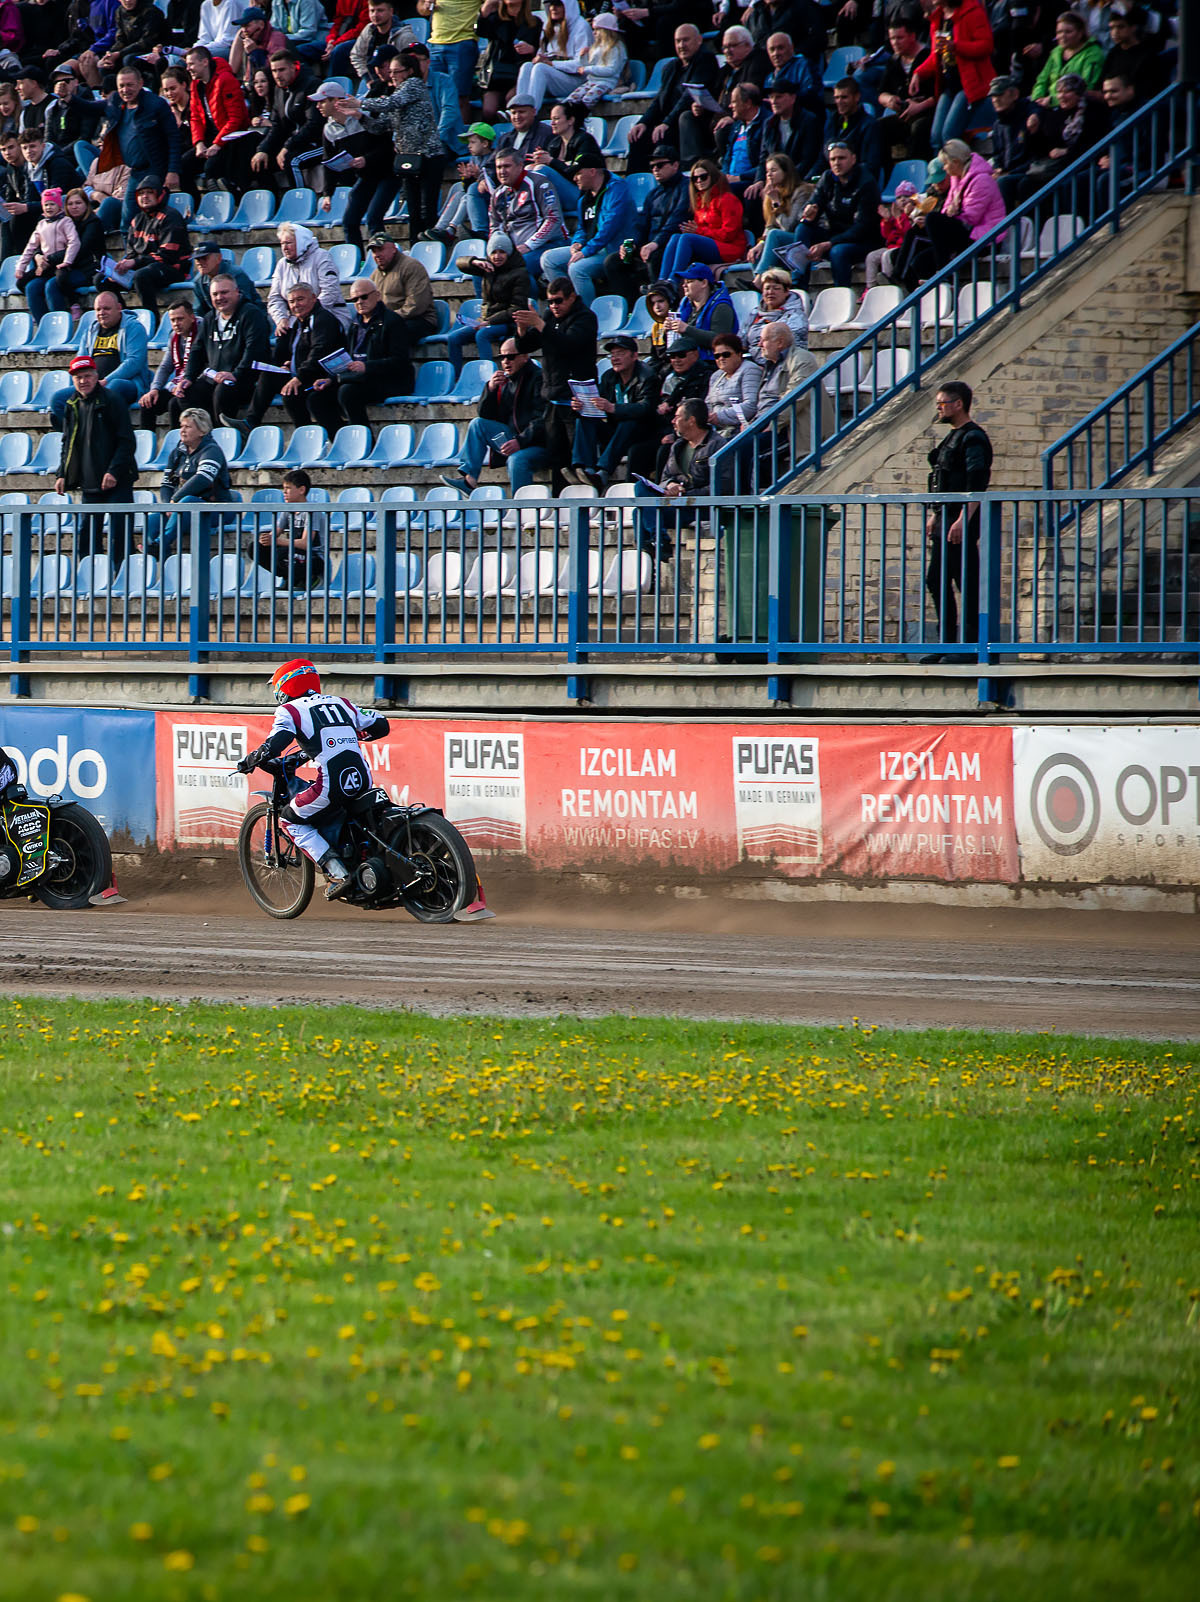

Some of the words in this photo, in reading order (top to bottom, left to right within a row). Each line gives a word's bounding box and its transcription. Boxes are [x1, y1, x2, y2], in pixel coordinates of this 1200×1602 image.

[319, 705, 345, 723] 11
[177, 730, 242, 761] PUFAS
[449, 738, 519, 770] PUFAS
[738, 743, 813, 775] PUFAS
[580, 748, 676, 777] IZCILAM
[879, 751, 981, 781] IZCILAM
[177, 774, 196, 787] MADE
[198, 775, 207, 788] IN
[210, 776, 243, 789] GERMANY
[449, 784, 470, 797] MADE
[473, 785, 481, 797] IN
[484, 785, 520, 798] GERMANY
[561, 789, 697, 819] REMONTAM
[739, 790, 761, 803] MADE
[764, 791, 773, 803] IN
[776, 791, 816, 804] GERMANY
[861, 794, 1002, 824] REMONTAM
[563, 828, 698, 849] WWW.PUFAS.LV
[863, 833, 1003, 855] WWW.PUFAS.LV
